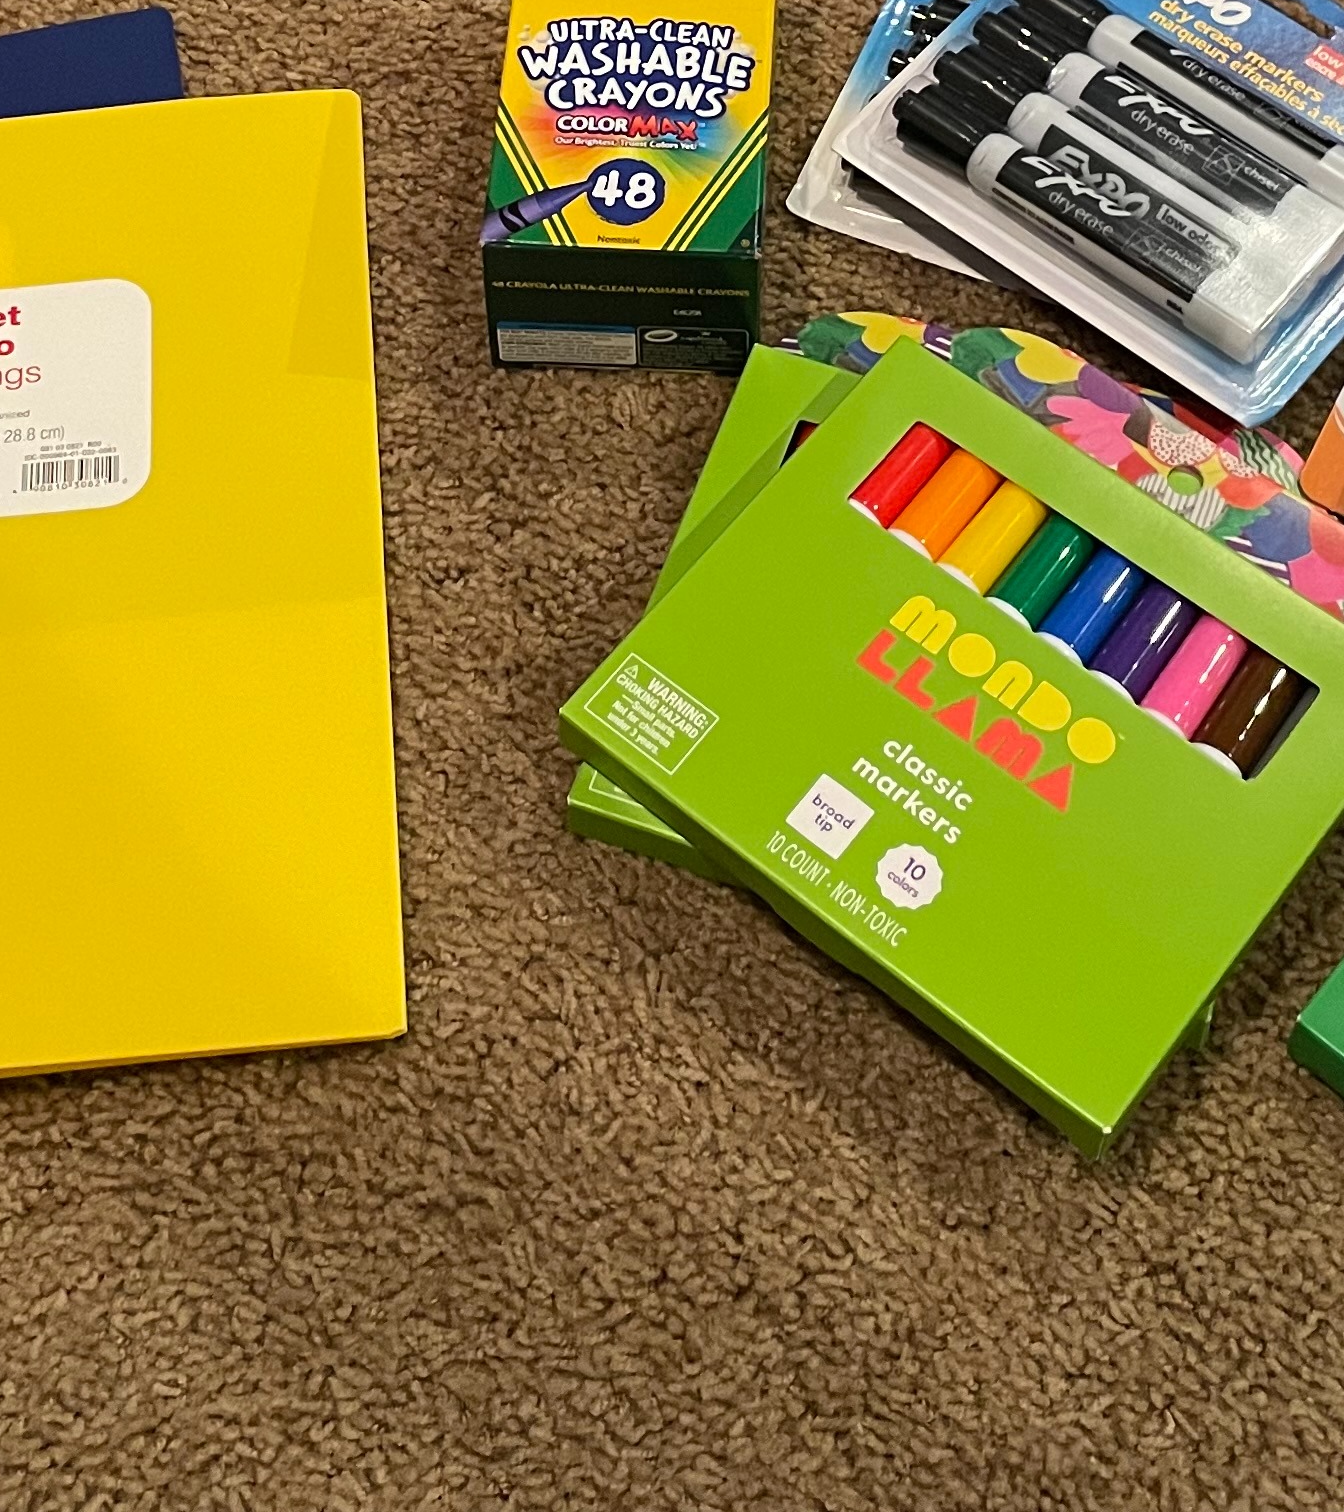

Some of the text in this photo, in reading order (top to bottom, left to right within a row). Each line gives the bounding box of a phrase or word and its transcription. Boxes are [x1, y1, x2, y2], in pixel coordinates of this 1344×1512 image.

[548, 18, 732, 49] ULTRA-CLEAN
[1148, 10, 1230, 64] marqueurs
[520, 43, 753, 90] WASHABLE
[1181, 57, 1246, 102] dry erase
[1193, 19, 1243, 54] erase
[1244, 50, 1324, 102] markers
[1312, 45, 1344, 69] low
[548, 78, 725, 116] CRAYONS
[1130, 109, 1197, 155] dry erase
[591, 170, 657, 210] 48
[1048, 190, 1077, 215] dry
[1074, 206, 1115, 237] erase
[1159, 208, 1187, 233] low
[506, 281, 558, 290] CRAYOLA
[697, 289, 751, 298] CRAYONS
[3, 427, 37, 443] 28.8
[40, 425, 66, 441] cm)
[612, 700, 671, 749] Not for children
[616, 673, 700, 740] CHOKING HAZARD
[646, 676, 709, 731] WARNING:
[856, 629, 1074, 813] LLAMA
[883, 739, 973, 812] classic
[812, 792, 856, 831] broad
[814, 811, 835, 833] tip
[852, 757, 963, 845] markers
[766, 829, 908, 948] 10 COUNT NON-TOXIC
[886, 870, 920, 899] colors
[903, 856, 927, 882] 10
